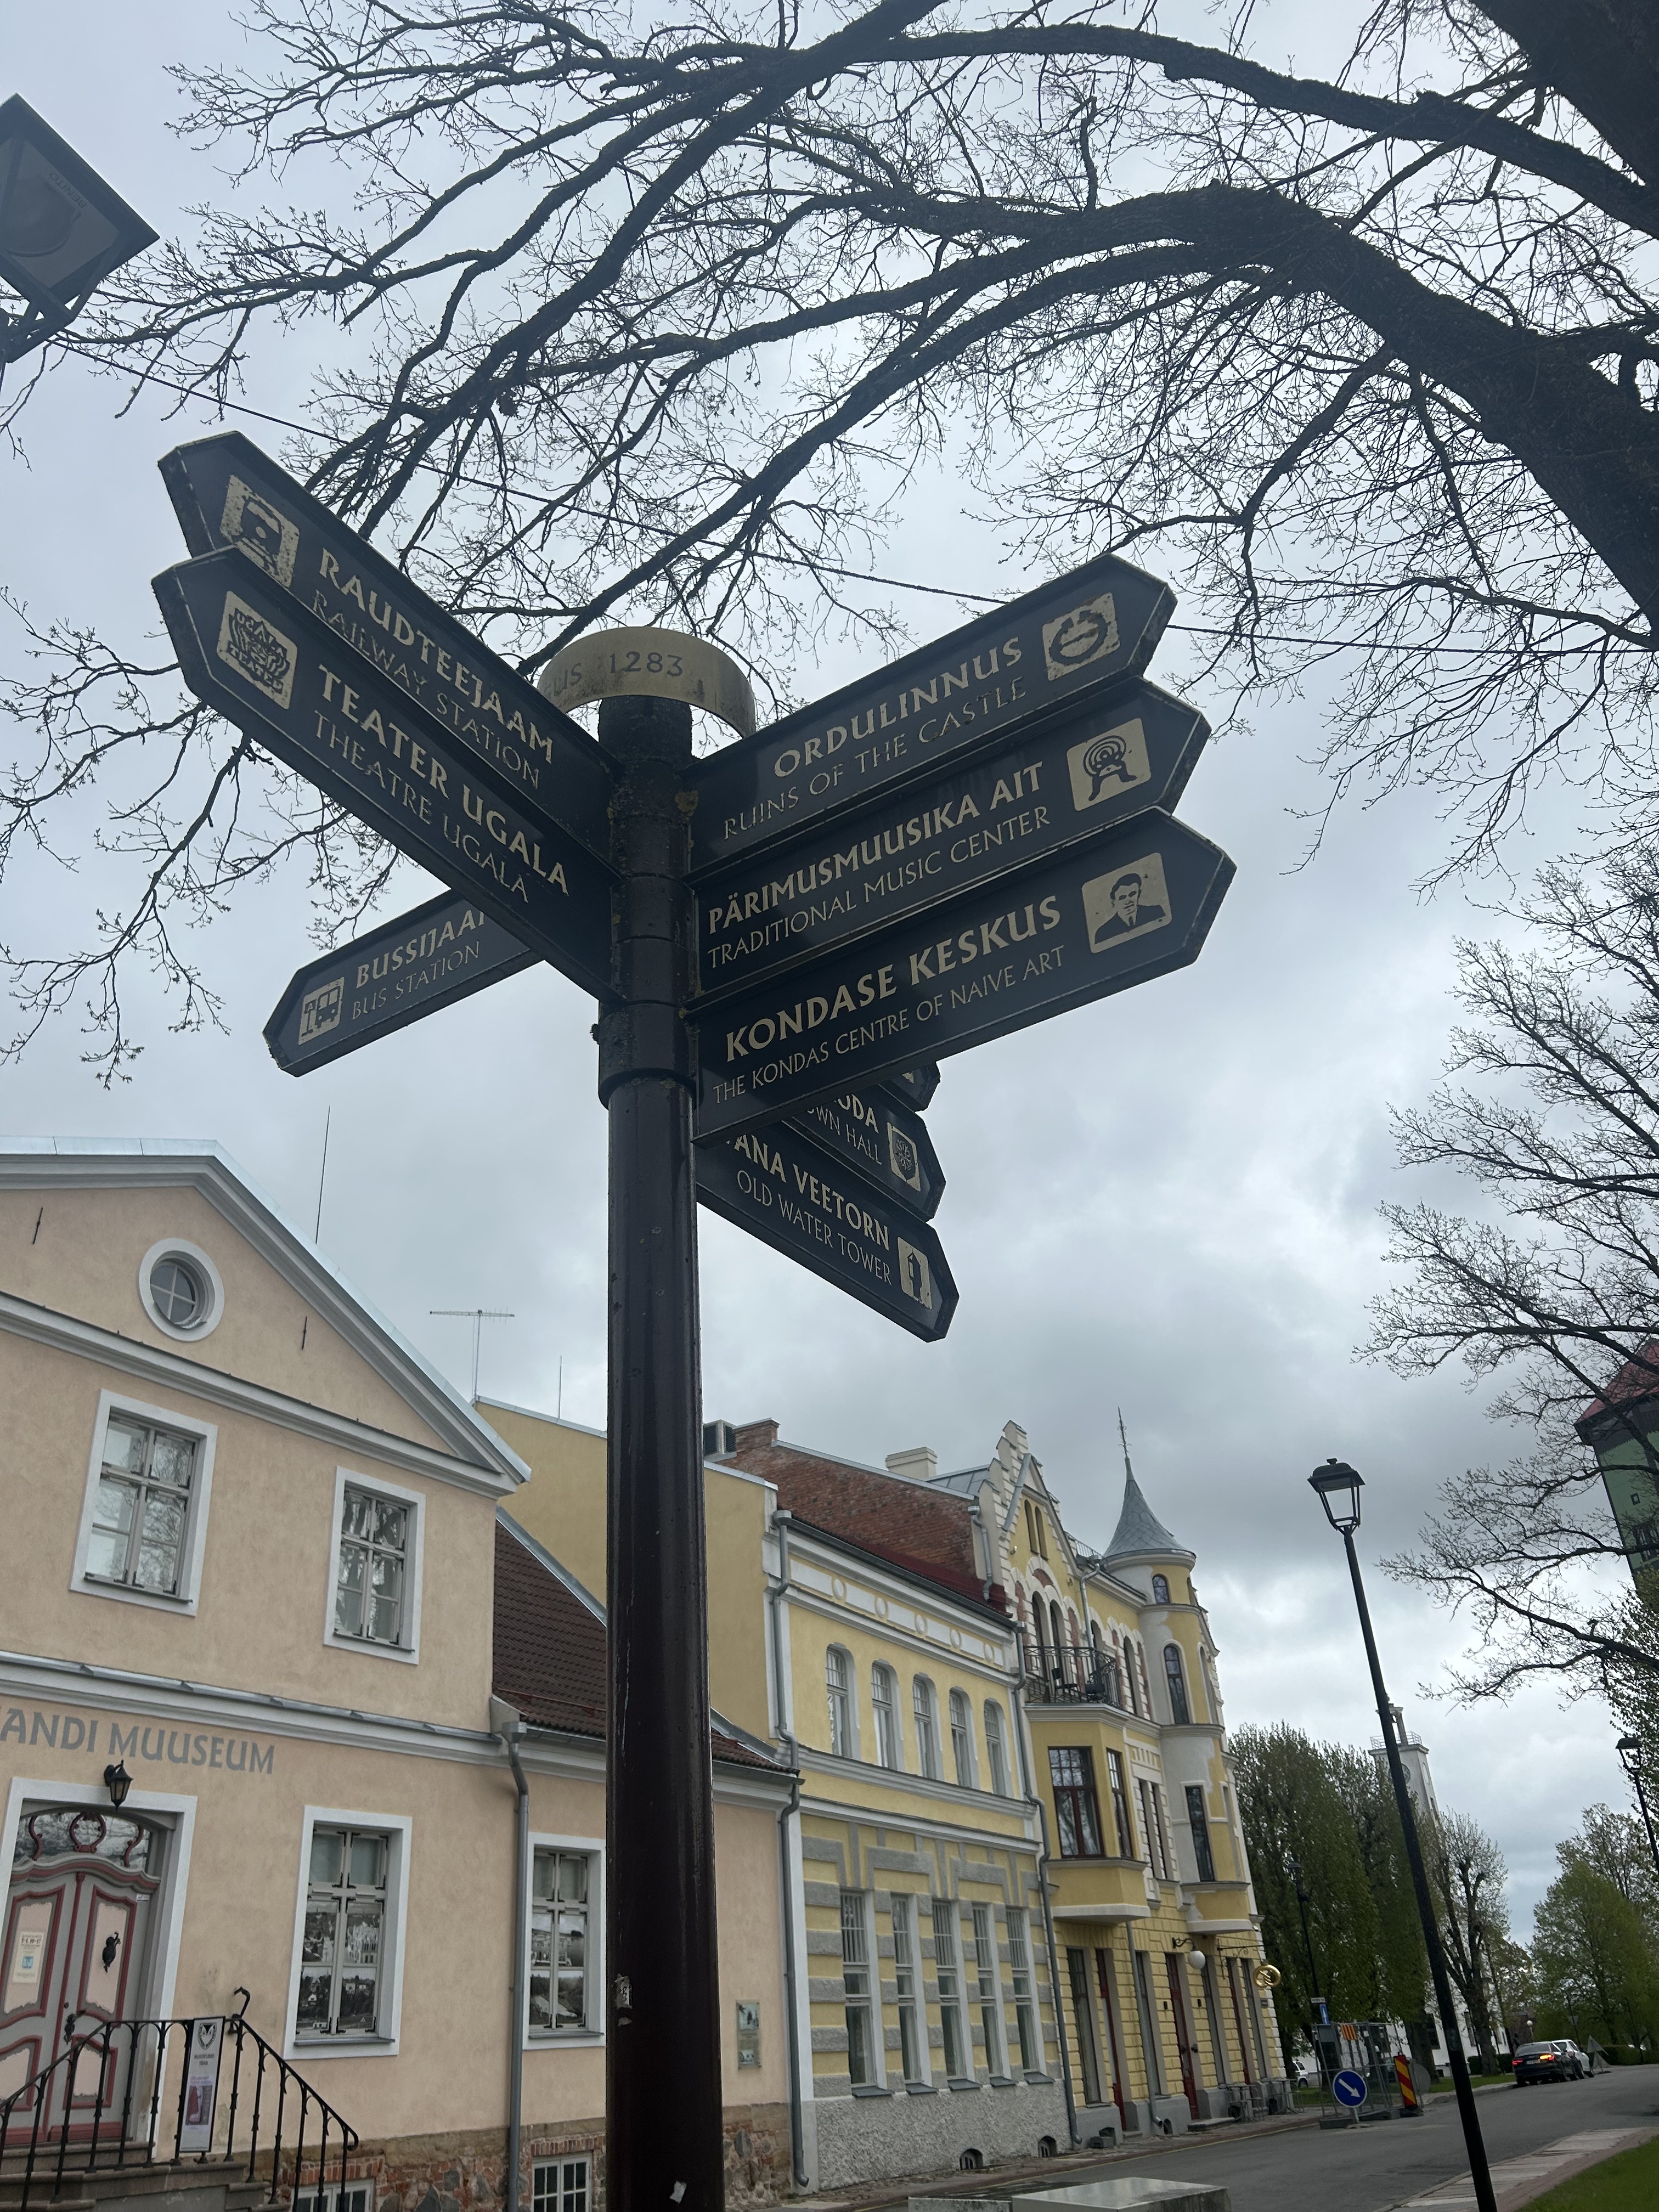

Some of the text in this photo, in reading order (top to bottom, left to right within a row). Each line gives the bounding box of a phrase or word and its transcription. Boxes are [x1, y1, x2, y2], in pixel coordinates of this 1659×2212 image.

[49, 172, 87, 208] BENITO
[313, 589, 540, 789] RAILWAY STATION
[320, 548, 553, 764] RAUDTEEJAAM
[610, 651, 683, 676] 1283
[774, 637, 1023, 777] ORDULINNUS
[314, 710, 529, 903] THEATRE UGALA
[319, 663, 569, 896] TEATER UGALA
[723, 677, 1027, 840] RUINS OF THE CASTLE
[708, 762, 1044, 934] PÄRIMUSMUUSIKA AIT
[708, 806, 1051, 969] TRADITIONAL MUSIC CENTER
[352, 941, 481, 1020] BUS STATION
[713, 946, 1065, 1104] THE KONDAS CENTRE OF NAIVE ART
[725, 895, 1061, 1062] KONDASE KESKUS
[833, 1094, 879, 1133] ODA
[847, 1124, 882, 1165] HALL
[726, 1133, 890, 1251] ANA VEETORN
[737, 1170, 892, 1286] OLD WATER TOWER
[0, 1706, 275, 1775] ANDI MUUSEUM
